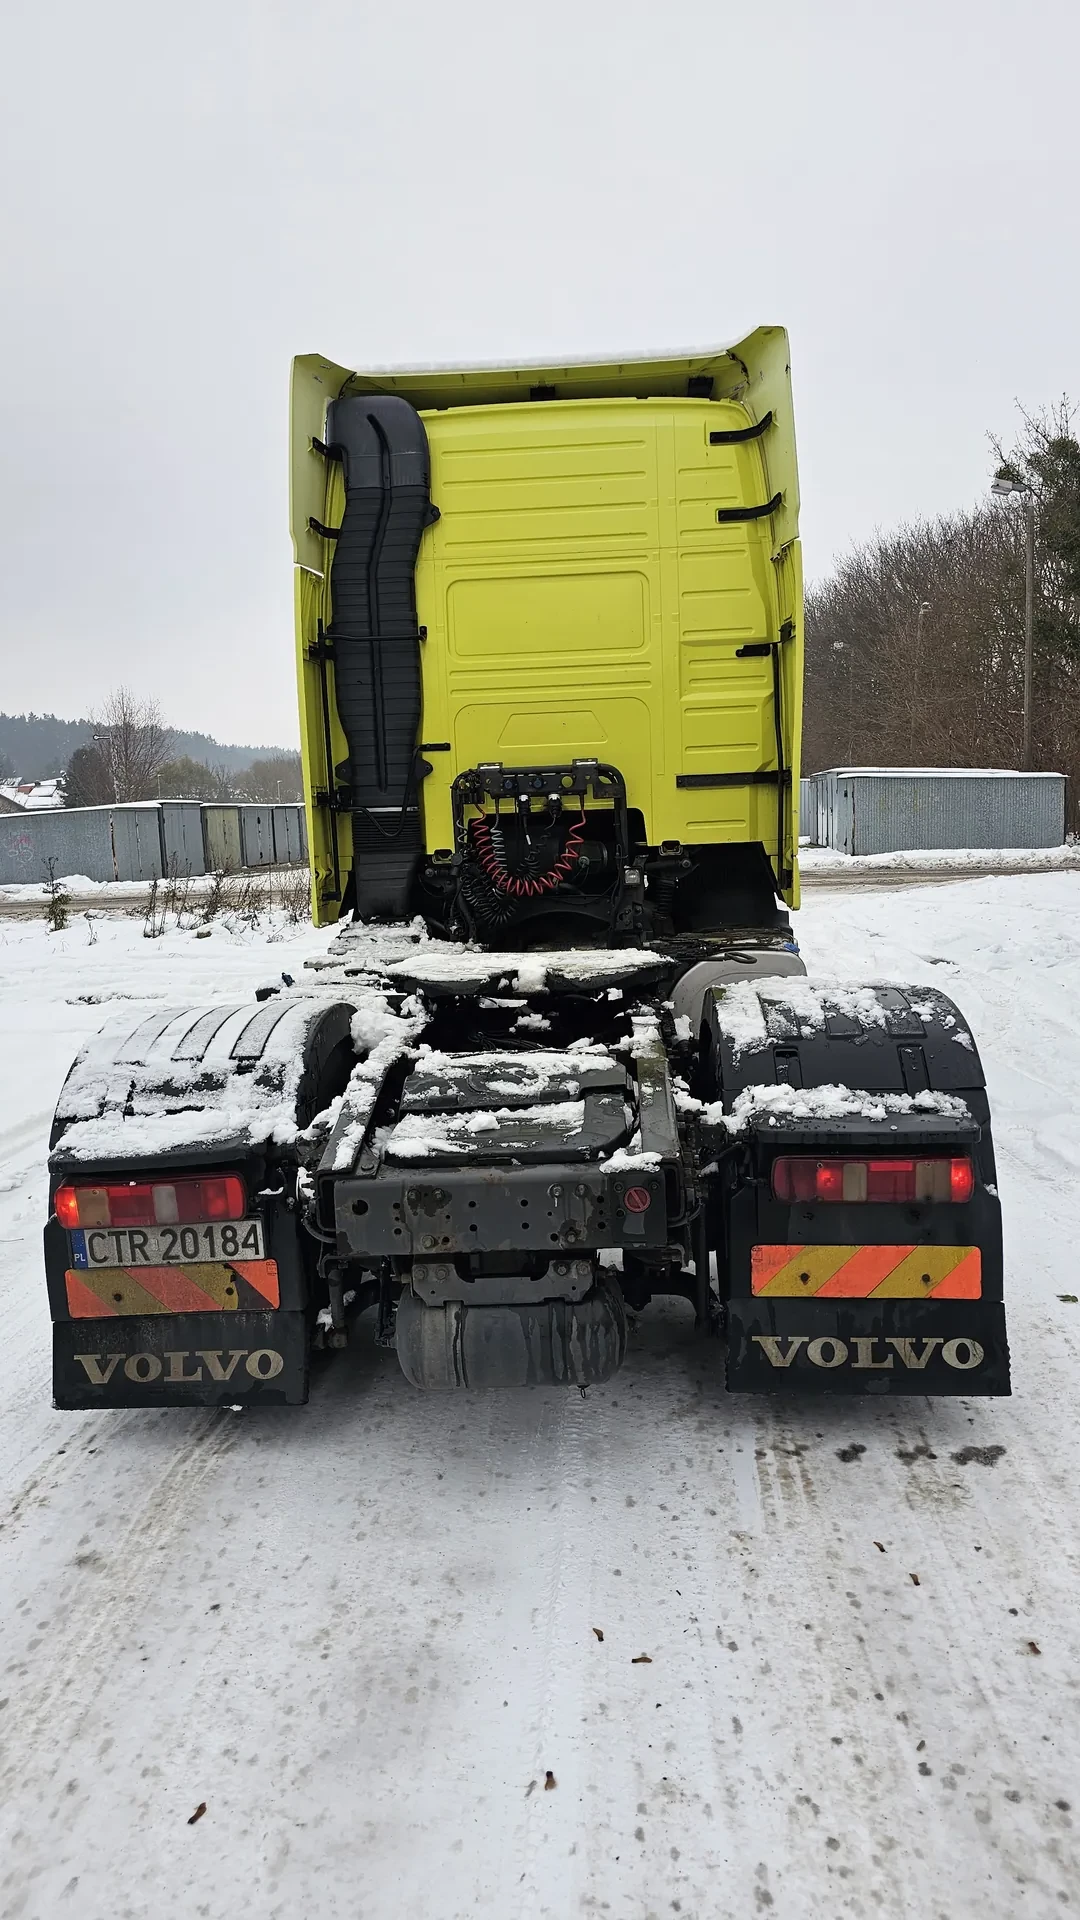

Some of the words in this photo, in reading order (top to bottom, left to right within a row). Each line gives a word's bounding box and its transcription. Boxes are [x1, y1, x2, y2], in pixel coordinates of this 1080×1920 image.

[74, 1253, 86, 1262] PL
[88, 1231, 149, 1263] CTR
[159, 1224, 260, 1260] 20184
[73, 1349, 284, 1384] VOLVO
[752, 1336, 985, 1369] VOLVO
